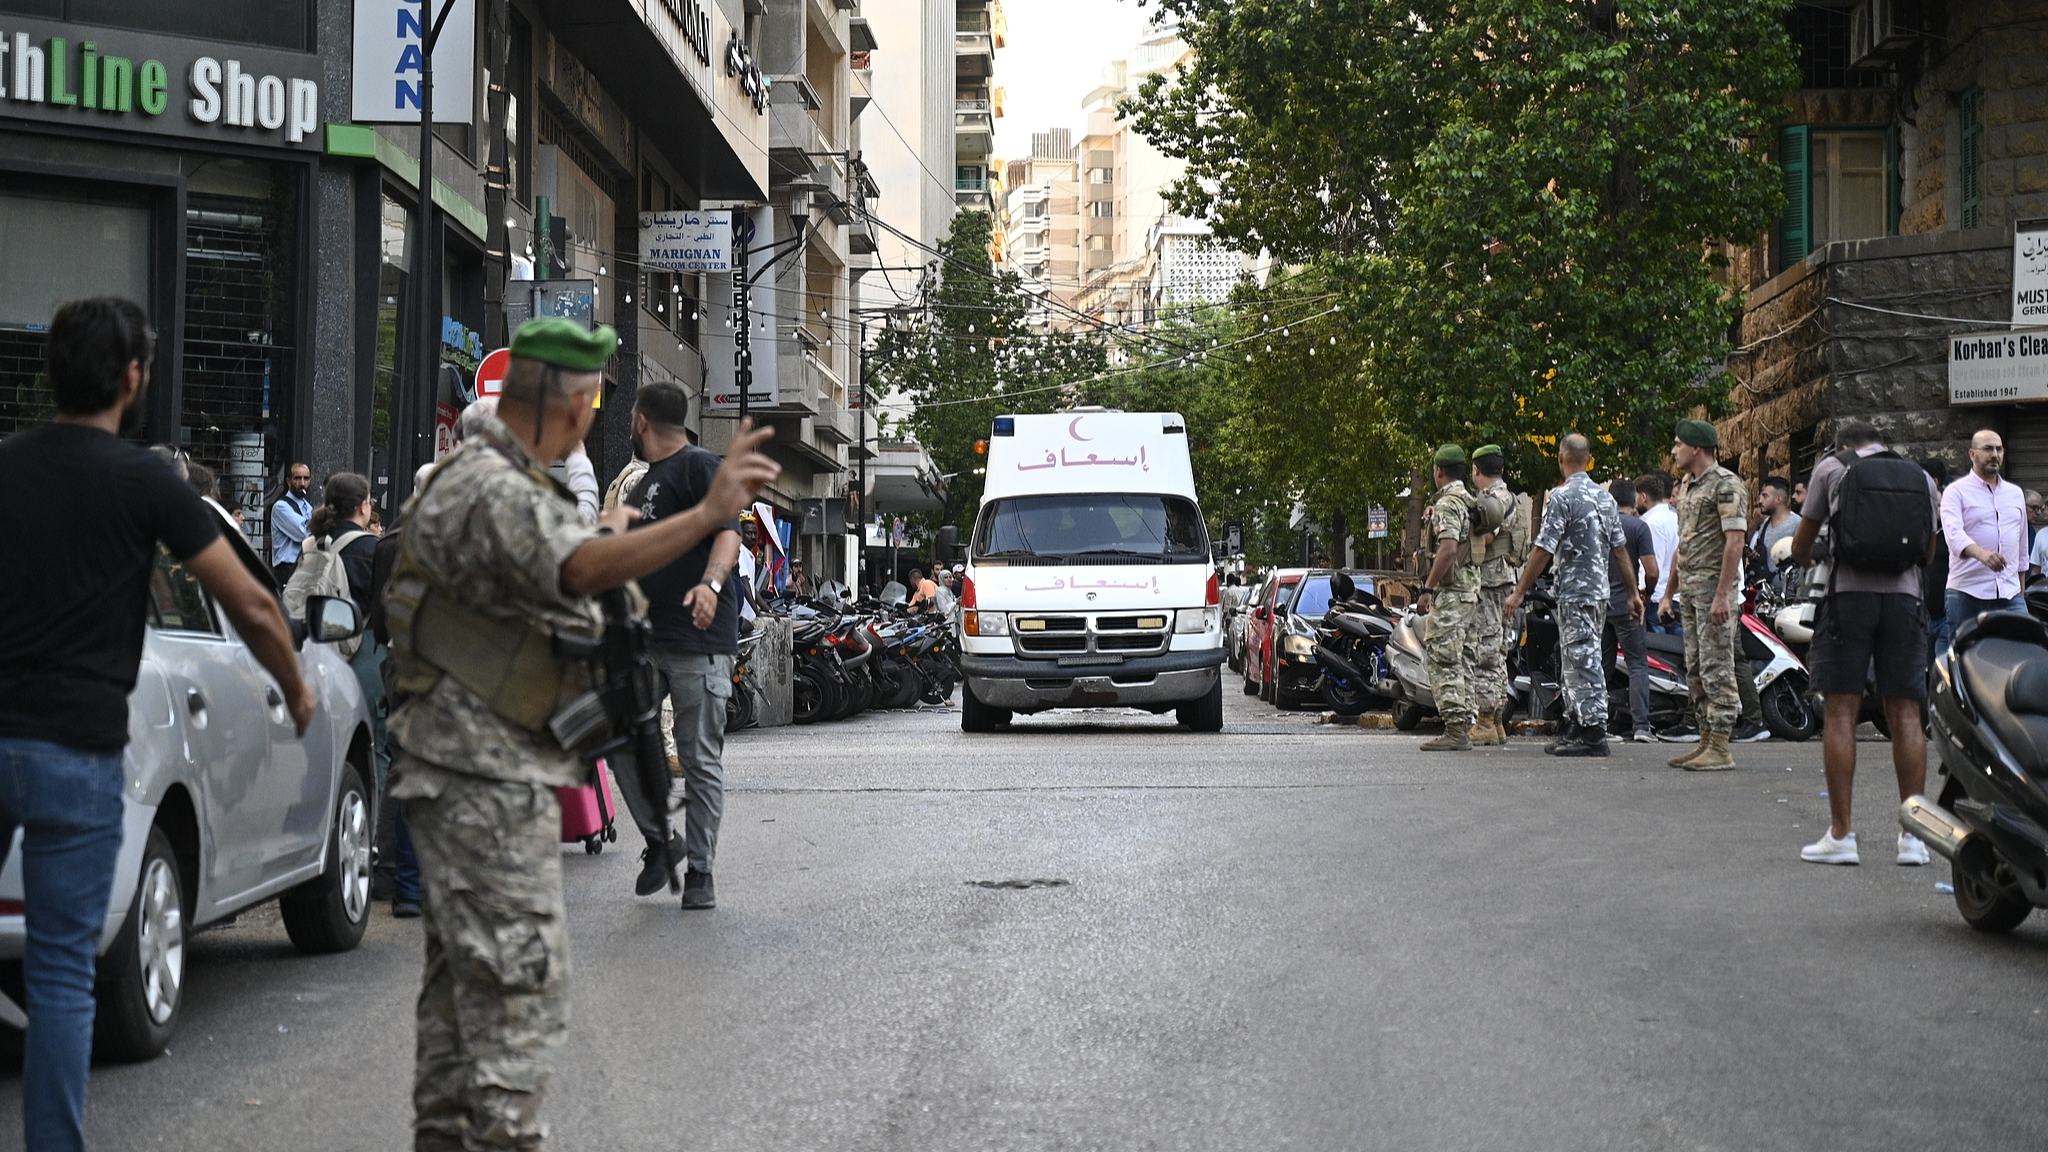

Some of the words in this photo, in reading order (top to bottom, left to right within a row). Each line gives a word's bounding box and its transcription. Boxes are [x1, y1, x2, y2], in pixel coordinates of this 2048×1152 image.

[395, 0, 424, 109] NAN
[189, 57, 318, 143] Shop
[705, 217, 728, 228] سنتر
[650, 249, 721, 259] MARIGNAN
[644, 262, 685, 270] MEDCOM
[2022, 305, 2048, 316] GENE
[1955, 337, 2015, 361] Korban's
[2003, 365, 2016, 379] and
[2018, 364, 2041, 377] Steam
[1955, 388, 1998, 399] Established
[2000, 387, 2018, 397] 1947
[1017, 445, 1149, 473] إسعاف
[1024, 575, 1160, 594] إسعاف
